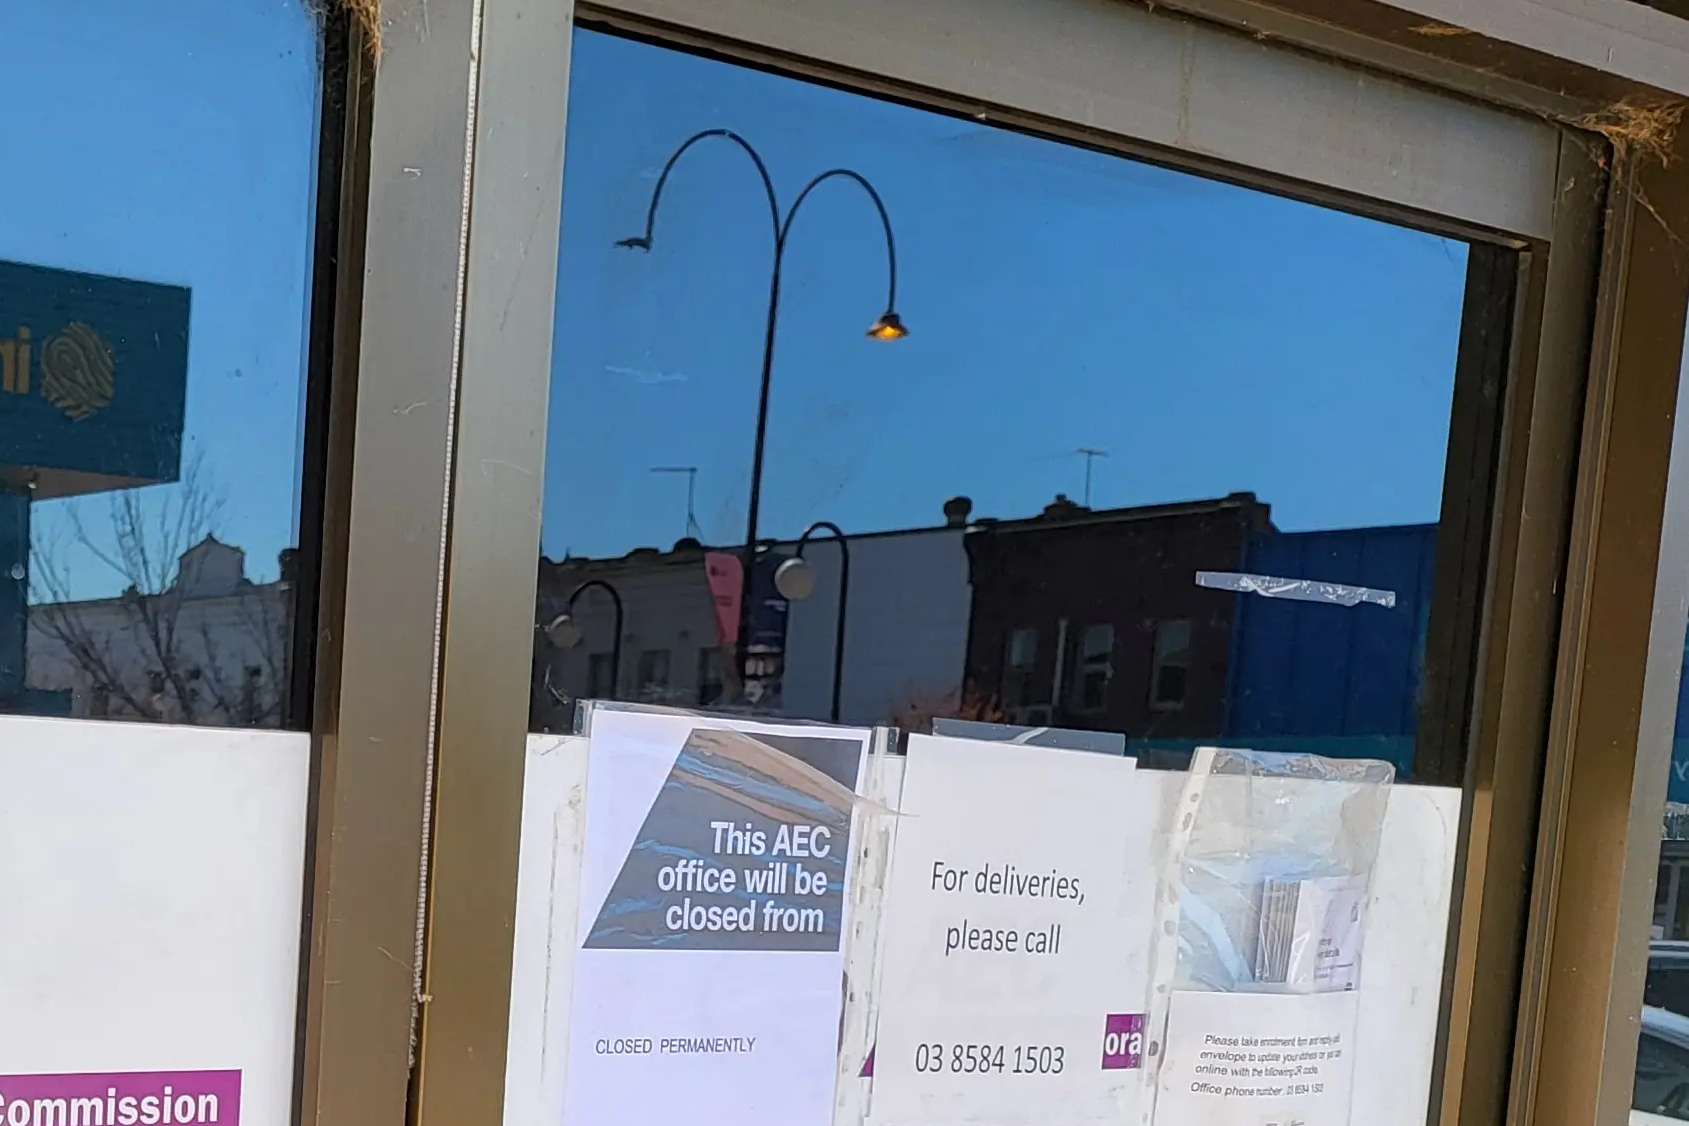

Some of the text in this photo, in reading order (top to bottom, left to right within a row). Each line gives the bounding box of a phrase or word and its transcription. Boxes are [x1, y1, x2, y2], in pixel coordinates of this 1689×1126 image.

[710, 821, 832, 858] This AEC
[657, 859, 828, 896] office will be
[931, 861, 1085, 906] For deliveries,
[666, 898, 824, 932] closed from
[945, 918, 1061, 956] please call
[595, 1037, 756, 1054] CLOSED PERMANENTLY
[1105, 1032, 1142, 1055] ora
[1204, 1035, 1239, 1046] Please
[1241, 1036, 1258, 1046] take
[915, 1044, 1064, 1074] 03 8584 1503
[1200, 1050, 1246, 1062] envelope
[1195, 1064, 1227, 1076] online
[1230, 1066, 1250, 1077] with
[1191, 1082, 1222, 1095] Office
[1224, 1085, 1254, 1096] phone
